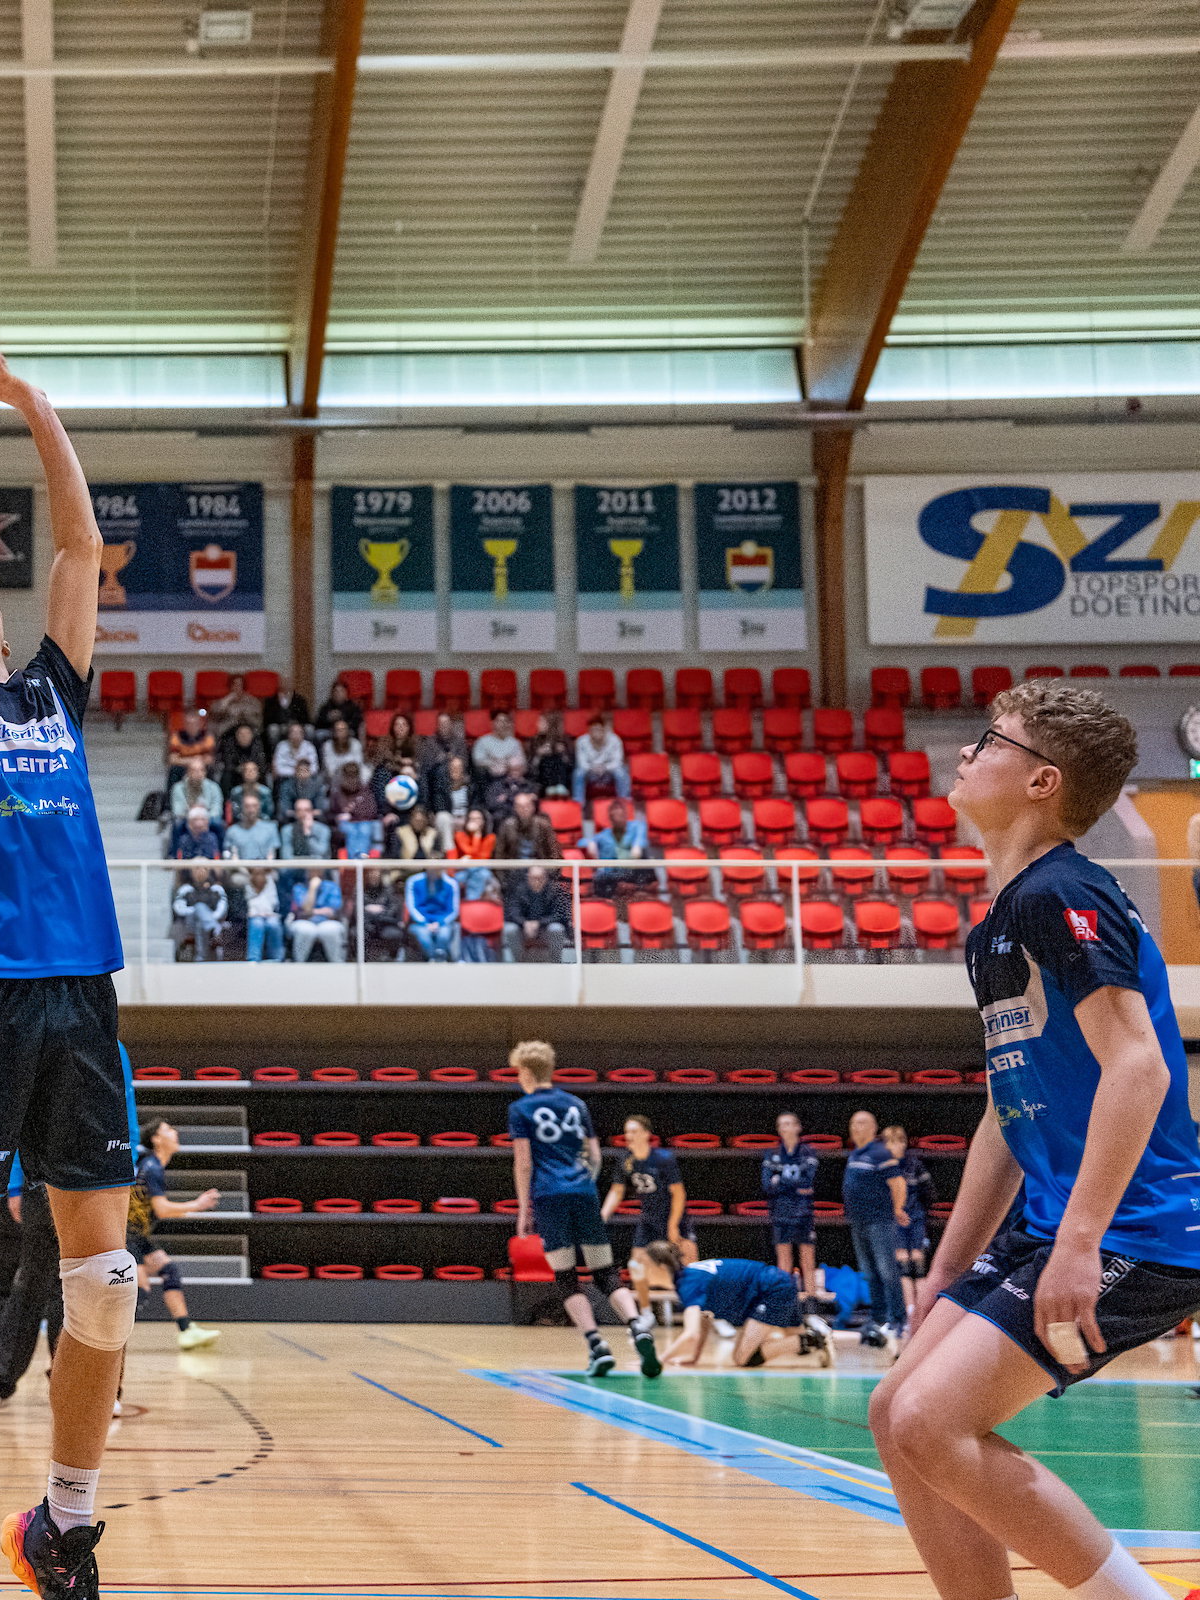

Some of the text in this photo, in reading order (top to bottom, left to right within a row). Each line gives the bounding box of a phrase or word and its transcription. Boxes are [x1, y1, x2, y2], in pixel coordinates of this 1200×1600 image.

[92, 495, 139, 517] 984
[188, 495, 241, 517] 1984
[353, 491, 413, 514] 1979
[473, 490, 532, 513] 2006
[597, 490, 656, 513] 2011
[718, 489, 777, 511] 2012
[1071, 573, 1200, 594] TOPSPOR
[533, 1106, 586, 1143] 84
